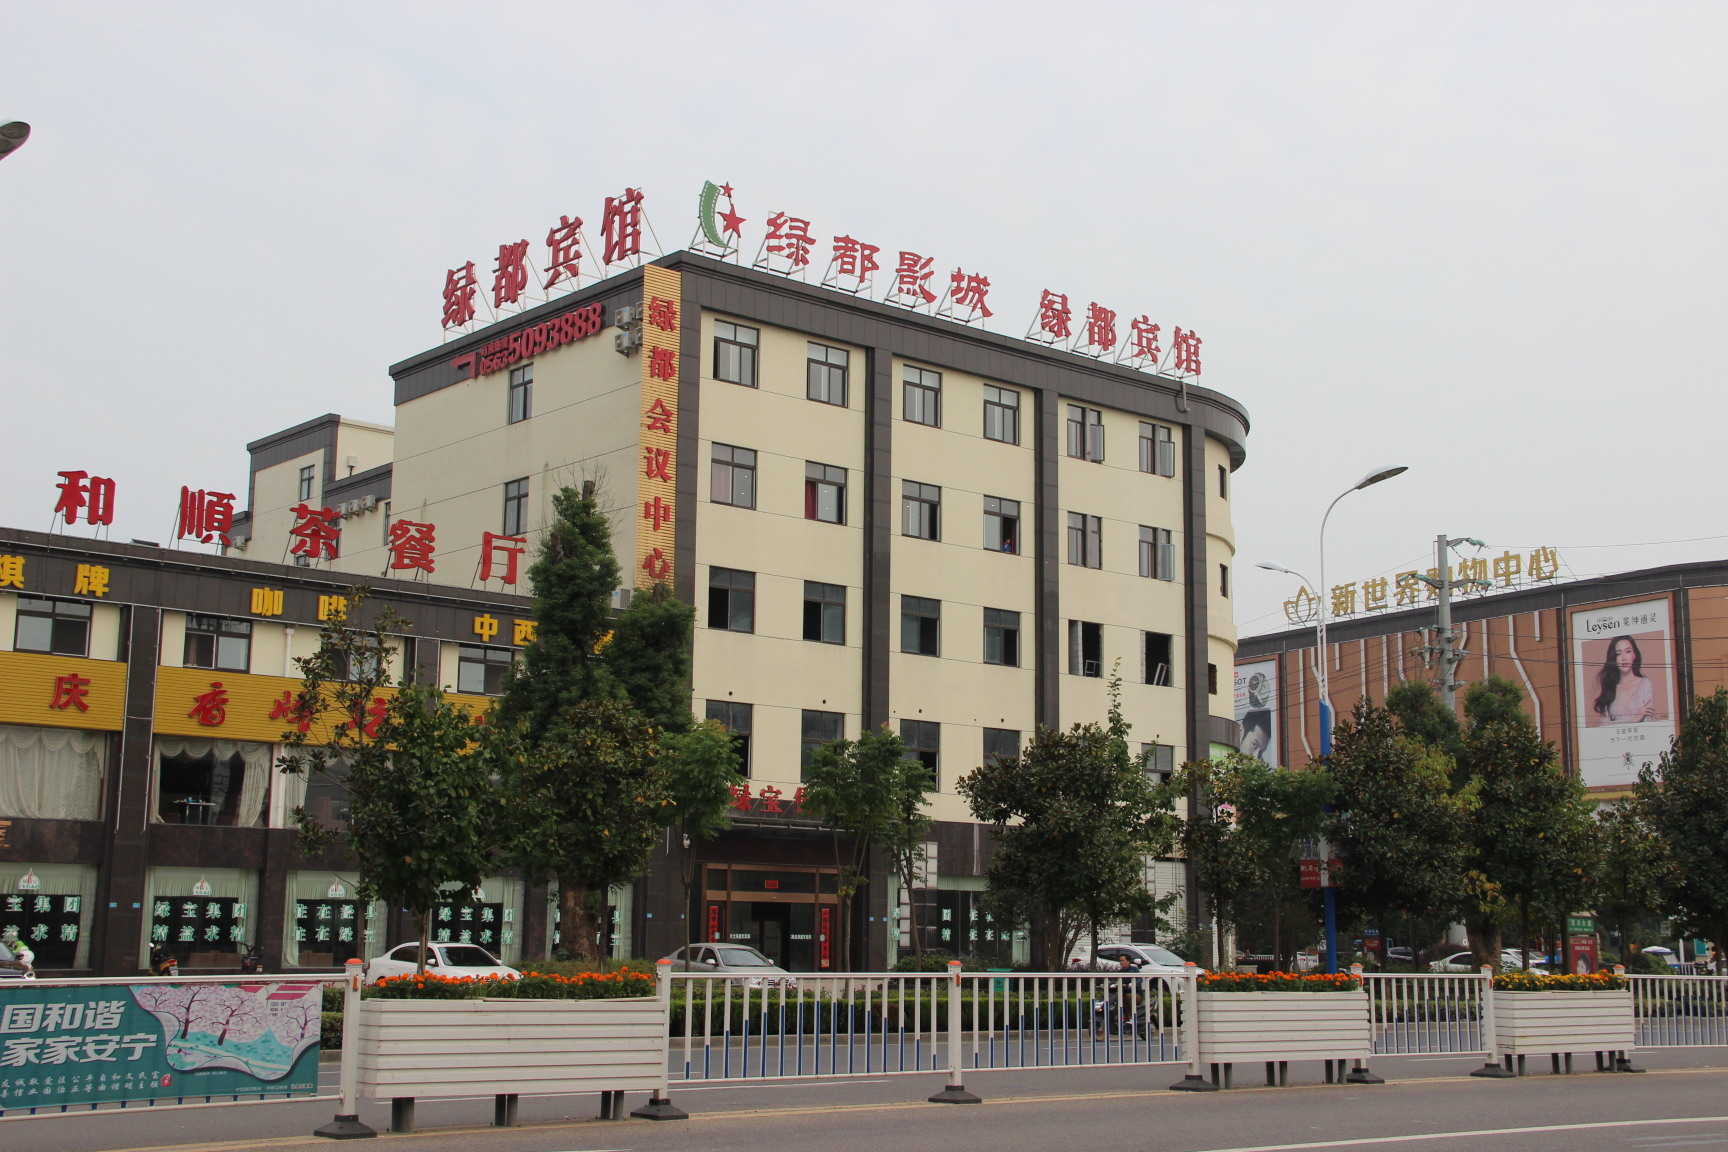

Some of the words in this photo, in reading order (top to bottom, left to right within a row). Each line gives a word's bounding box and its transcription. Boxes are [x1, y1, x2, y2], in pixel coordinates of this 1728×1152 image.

[442, 188, 644, 328] 绿都宾馆
[766, 211, 993, 317] 绿都影城
[508, 302, 602, 363] 5093888
[1040, 289, 1202, 376] 绿都宾馆
[642, 296, 678, 579] 绿都会议中心
[1331, 546, 1559, 617] 新世界购物中心
[1586, 619, 1620, 634] Leysen
[154, 901, 247, 918] 绿宝集团
[438, 906, 515, 923] 绿宝集团
[0, 1000, 127, 1034] 国和谐
[0, 1033, 157, 1067] 家家安宁
